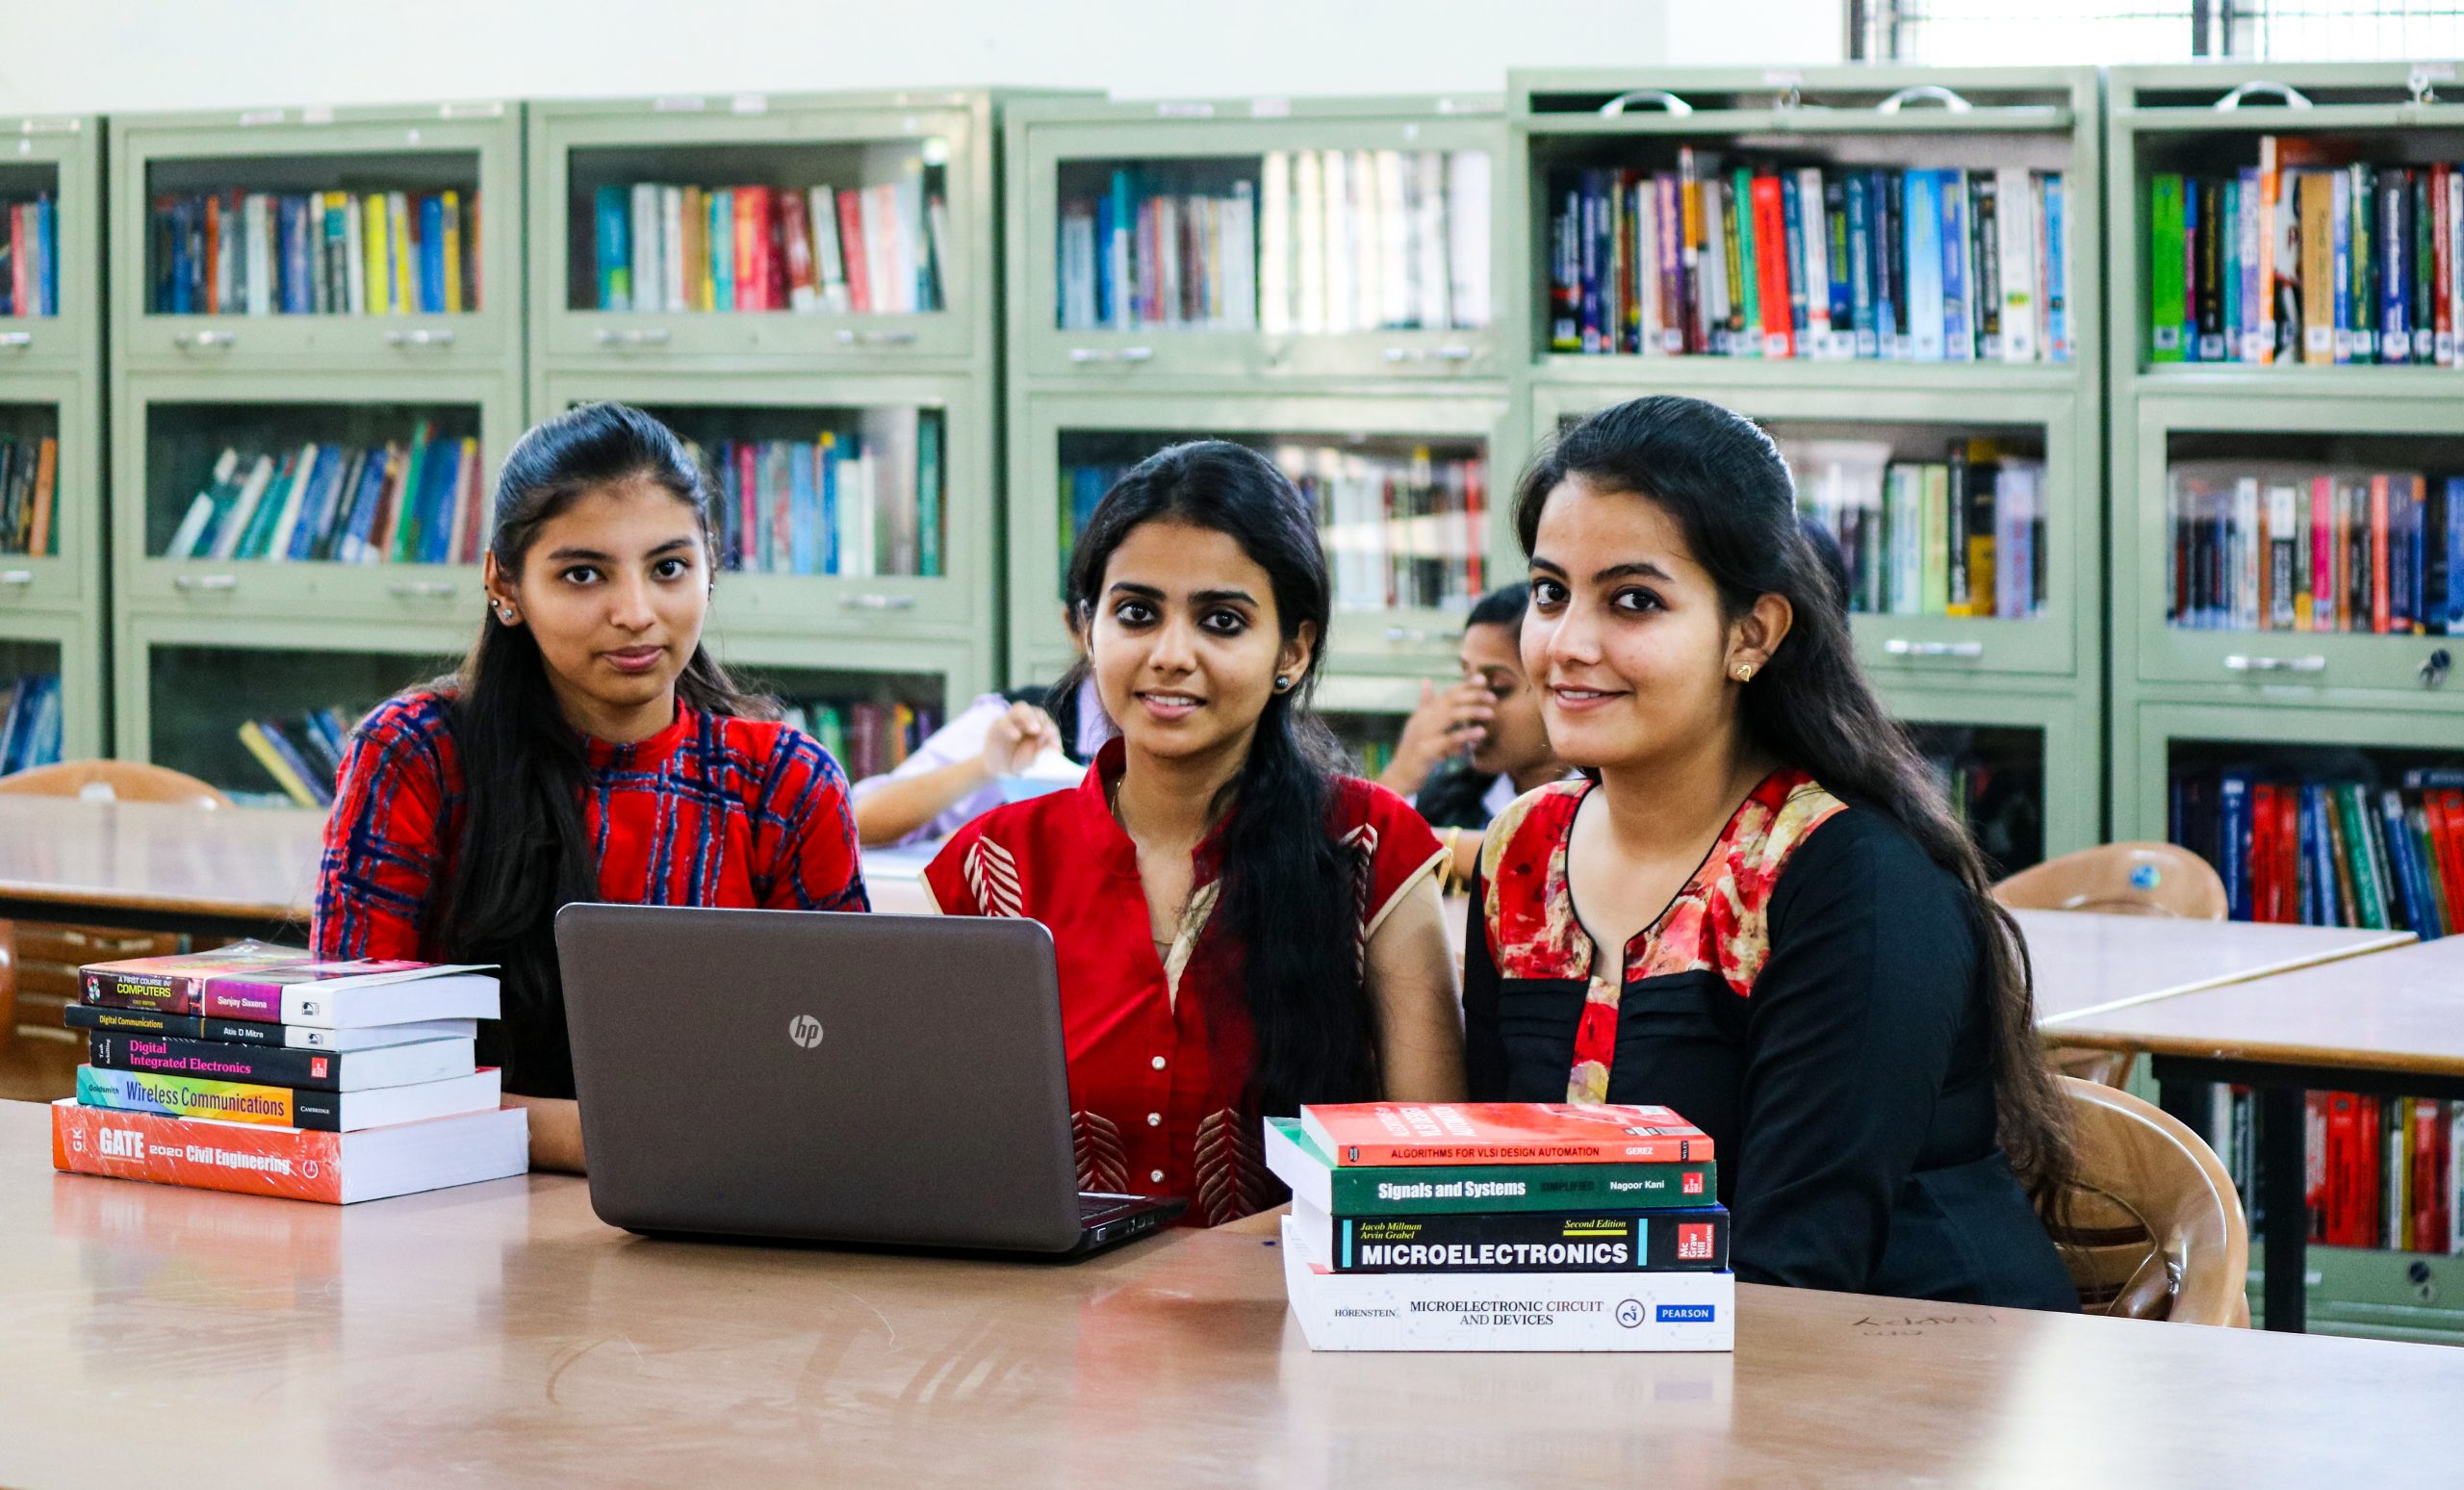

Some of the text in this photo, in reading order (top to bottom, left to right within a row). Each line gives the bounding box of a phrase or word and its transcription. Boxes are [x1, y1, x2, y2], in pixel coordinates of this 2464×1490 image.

[123, 976, 139, 985] FIRST
[141, 978, 162, 987] COURSE
[116, 983, 171, 998] COMPUTERS
[217, 995, 268, 1009] Sanjay Saxena
[99, 1015, 164, 1029] Digital Communications
[223, 1027, 264, 1039] Atis D Mitra
[129, 1040, 167, 1055] Digital
[130, 1054, 252, 1074] Integrated Electronics
[89, 1084, 119, 1094] Goldsmith
[126, 1081, 285, 1117] Wireless Communications
[73, 1128, 84, 1152] GK
[99, 1127, 291, 1175] GATE 2020 Civil Engineering
[1391, 1146, 1655, 1159] ALGORITHMS FOR VLSI DESIGN AUTOMATION GEREZ
[1377, 1182, 1433, 1201] Signals
[1435, 1181, 1463, 1195] and
[1464, 1180, 1527, 1198] Systems
[1609, 1180, 1643, 1193] Nagoor
[1644, 1179, 1665, 1191] Kani
[1359, 1221, 1423, 1232] Jacob Millman
[1564, 1219, 1627, 1229] Second Edition
[1359, 1230, 1416, 1241] Arvin Grabel
[1680, 1242, 1689, 1257] Mc
[1688, 1232, 1698, 1258] Graw
[1697, 1241, 1706, 1258] Hill
[1361, 1243, 1629, 1266] MICROELECTRONICS
[1334, 1308, 1397, 1318] HORENSTEIN
[1410, 1300, 1604, 1313] MICROELECTRONIC CIRCUIT
[1661, 1308, 1709, 1319] PEARSON
[1460, 1314, 1553, 1326] AND DEVICES
[1622, 1305, 1638, 1323] 2e
